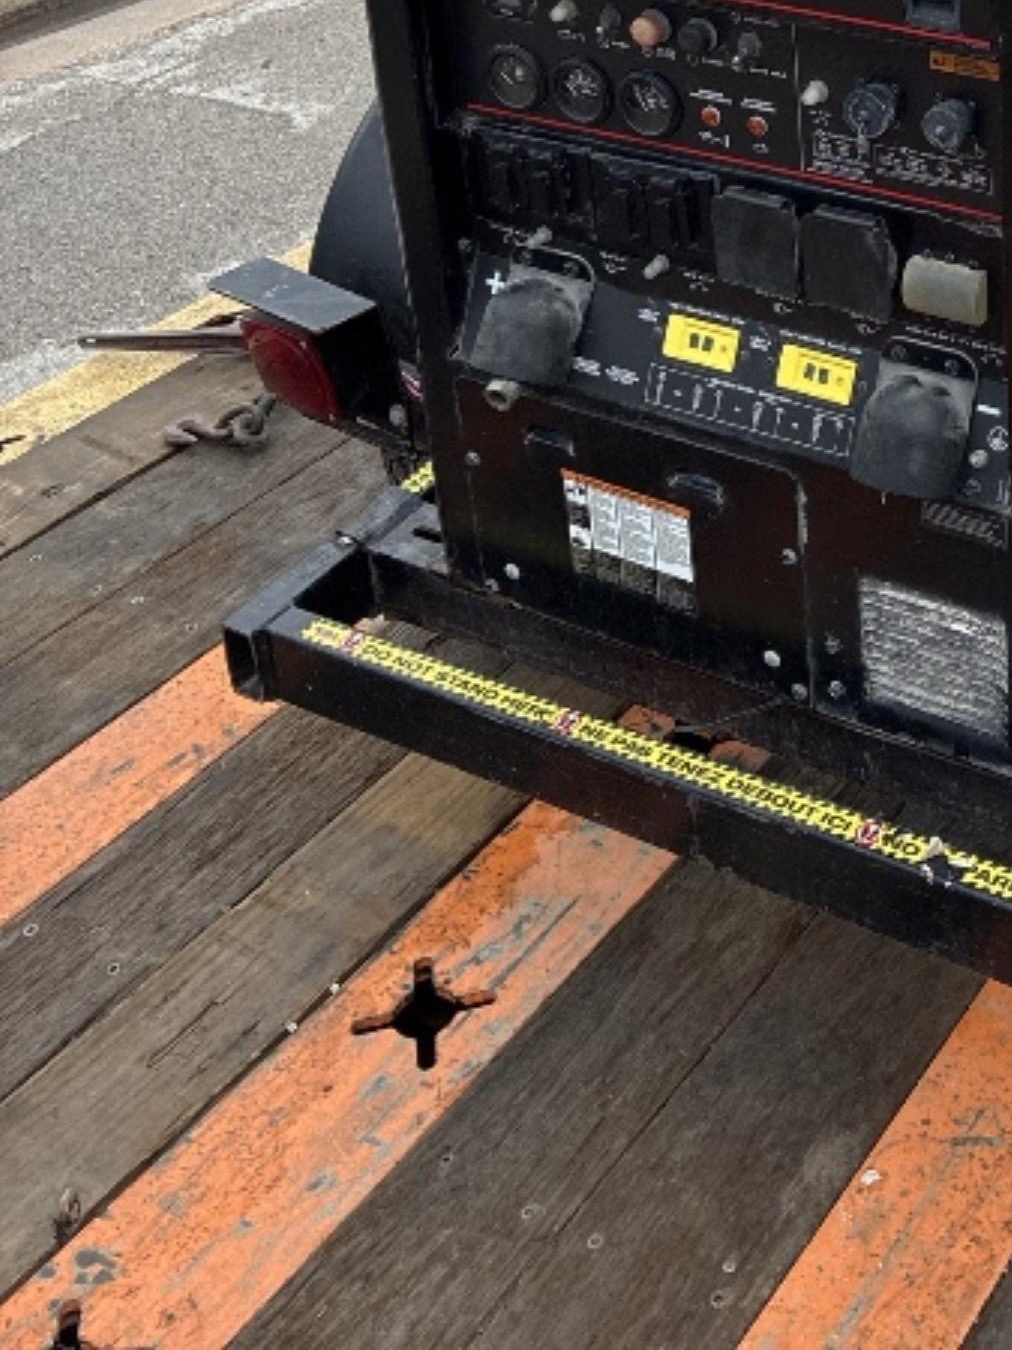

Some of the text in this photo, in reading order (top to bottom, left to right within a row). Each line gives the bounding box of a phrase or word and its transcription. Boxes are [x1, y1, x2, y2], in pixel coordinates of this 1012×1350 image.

[393, 657, 432, 676] NOT
[435, 670, 499, 700] STAND
[655, 752, 726, 782] TENEZ
[726, 776, 817, 818] DEBOUT
[820, 812, 853, 832] ICI
[881, 834, 921, 857] NO
